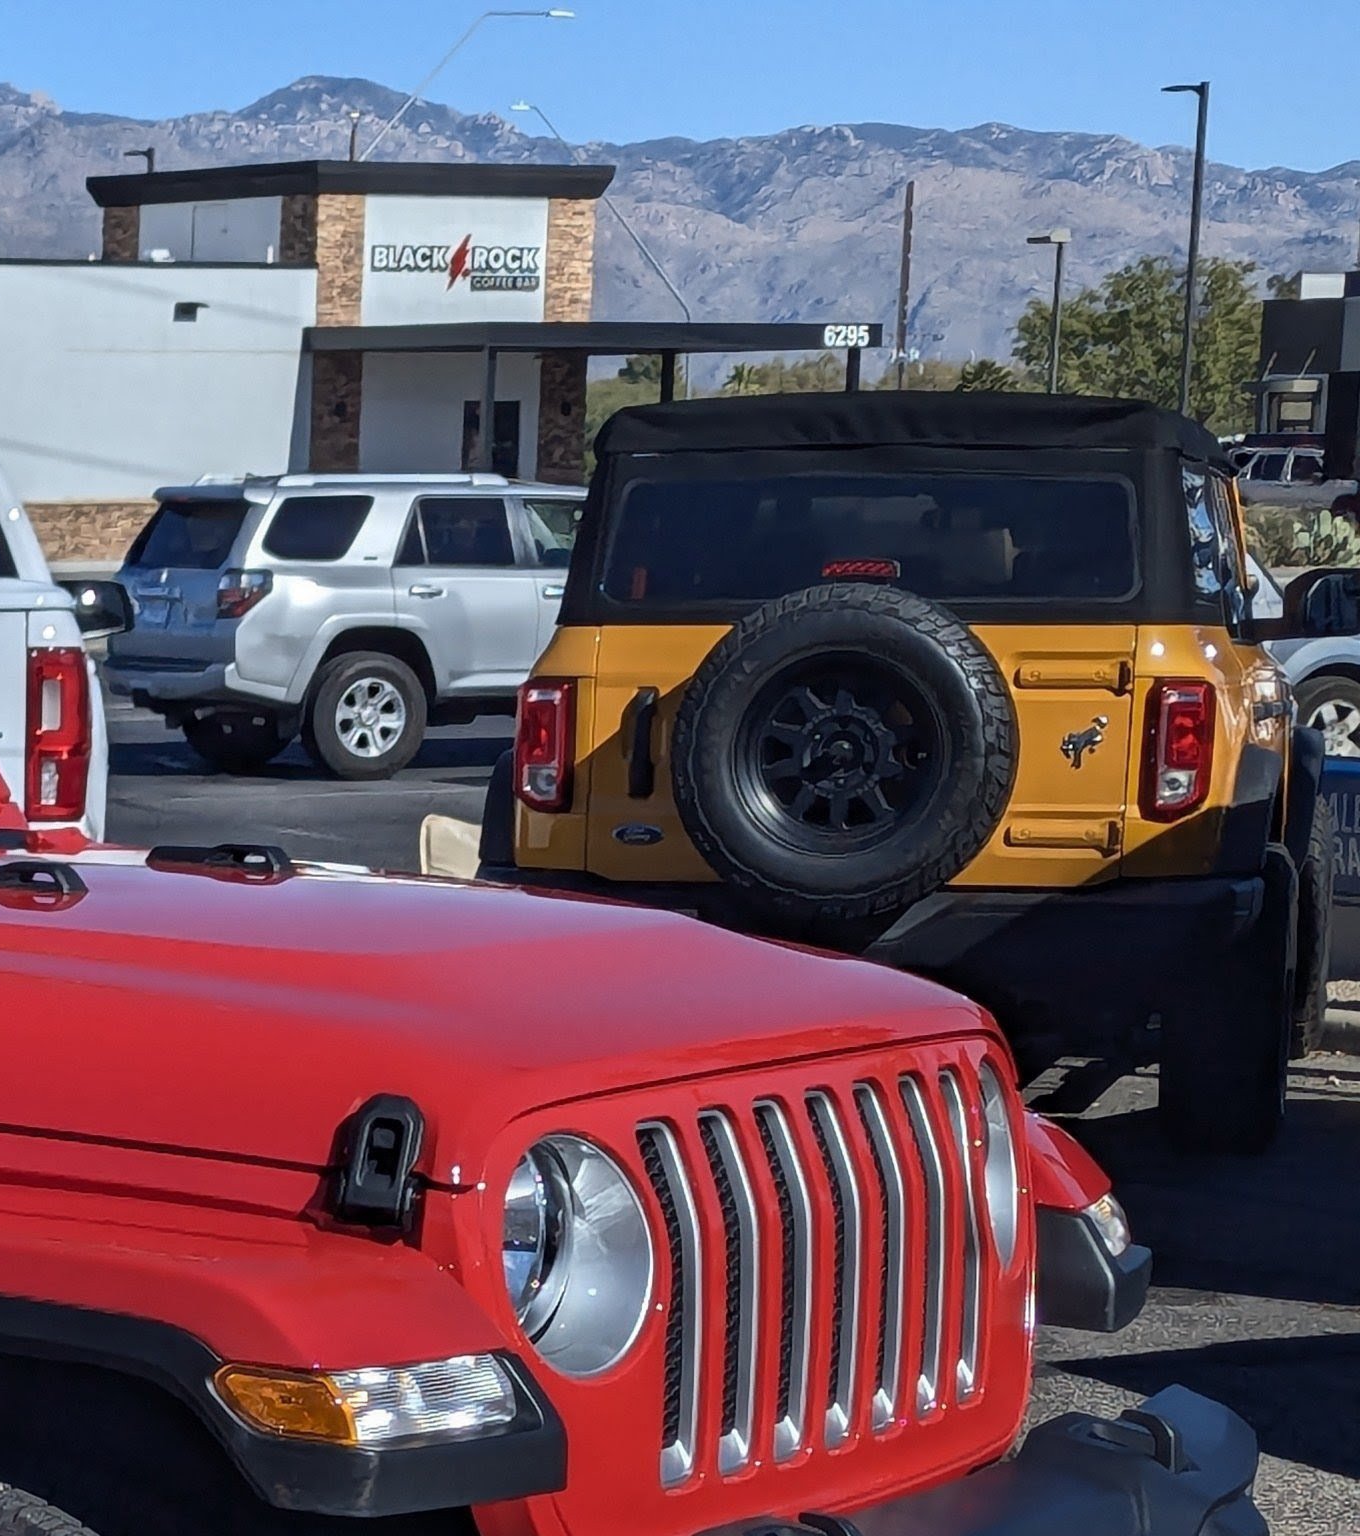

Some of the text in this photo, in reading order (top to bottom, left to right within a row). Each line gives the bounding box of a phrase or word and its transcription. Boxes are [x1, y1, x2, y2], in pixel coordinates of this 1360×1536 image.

[370, 245, 541, 273] BLACK ROCK
[823, 323, 870, 348] 6295
